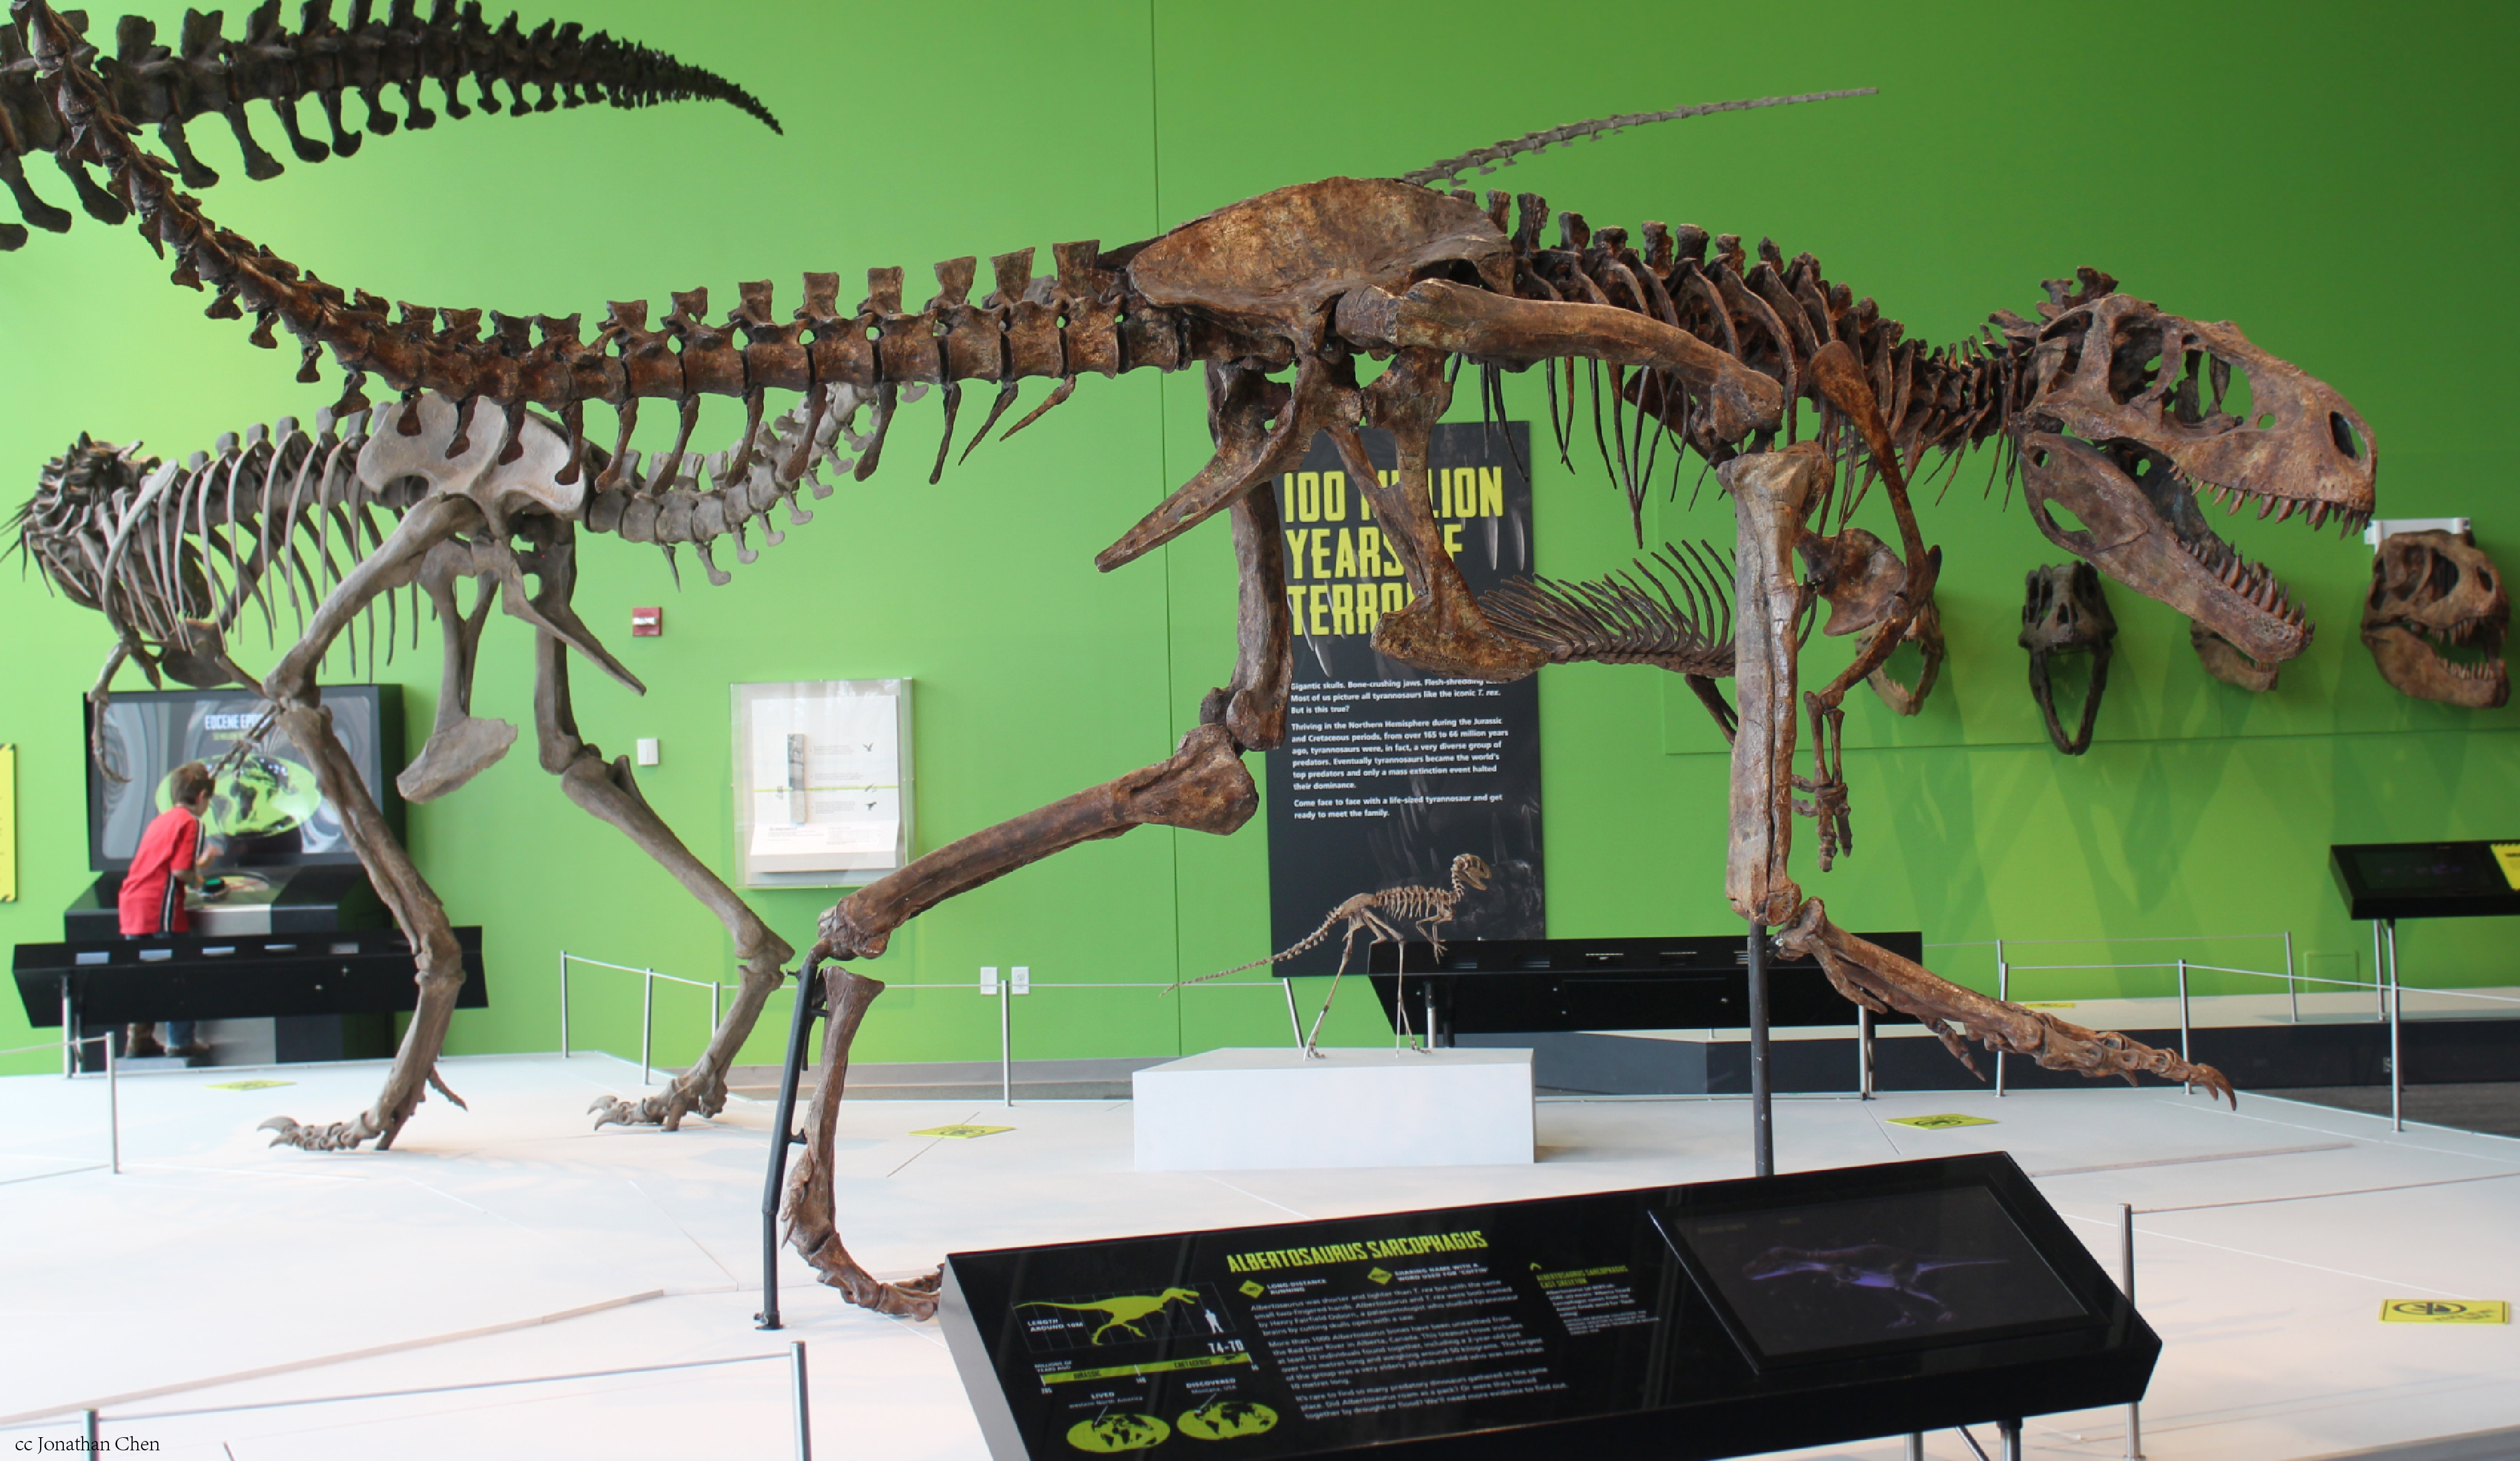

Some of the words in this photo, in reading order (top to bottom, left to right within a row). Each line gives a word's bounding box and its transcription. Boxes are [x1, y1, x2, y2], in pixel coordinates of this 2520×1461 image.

[1284, 471, 1346, 522] 100
[1285, 525, 1405, 579] YEARS
[1287, 582, 1416, 636] TERRO
[1291, 681, 1321, 691] Gigantic
[1348, 679, 1402, 688] Bone-crushing
[1311, 693, 1320, 701] of
[1333, 693, 1360, 703] picture
[1372, 692, 1422, 701] tyrannosaurs
[1423, 690, 1437, 698] like
[1314, 705, 1329, 713] this
[1330, 705, 1350, 713] true?
[1291, 723, 1323, 731] Thriving
[1385, 720, 1430, 728] Hemisphere
[1432, 719, 1457, 727] during
[1459, 718, 1472, 726] the
[1292, 735, 1306, 743] and
[1384, 731, 1403, 740] from
[1489, 730, 1508, 738] years
[1311, 746, 1360, 755] tyrannosaurs
[1333, 756, 1372, 766] Eventually
[1375, 756, 1423, 765] tyrannosaurs
[1471, 753, 1499, 761] world's
[1308, 770, 1344, 779] predators
[1363, 768, 1380, 777] only
[1409, 767, 1447, 775] extinction
[1345, 797, 1361, 805] face
[1363, 797, 1381, 805] with
[1390, 795, 1423, 804] life-sized
[1425, 796, 1471, 804] tyrannosaur
[1294, 811, 1316, 820] ready
[1227, 1242, 1368, 1273] ALBERTOSAURUS
[1366, 1231, 1488, 1259] SARCOPHAGUS
[1207, 1339, 1245, 1355] 74-70
